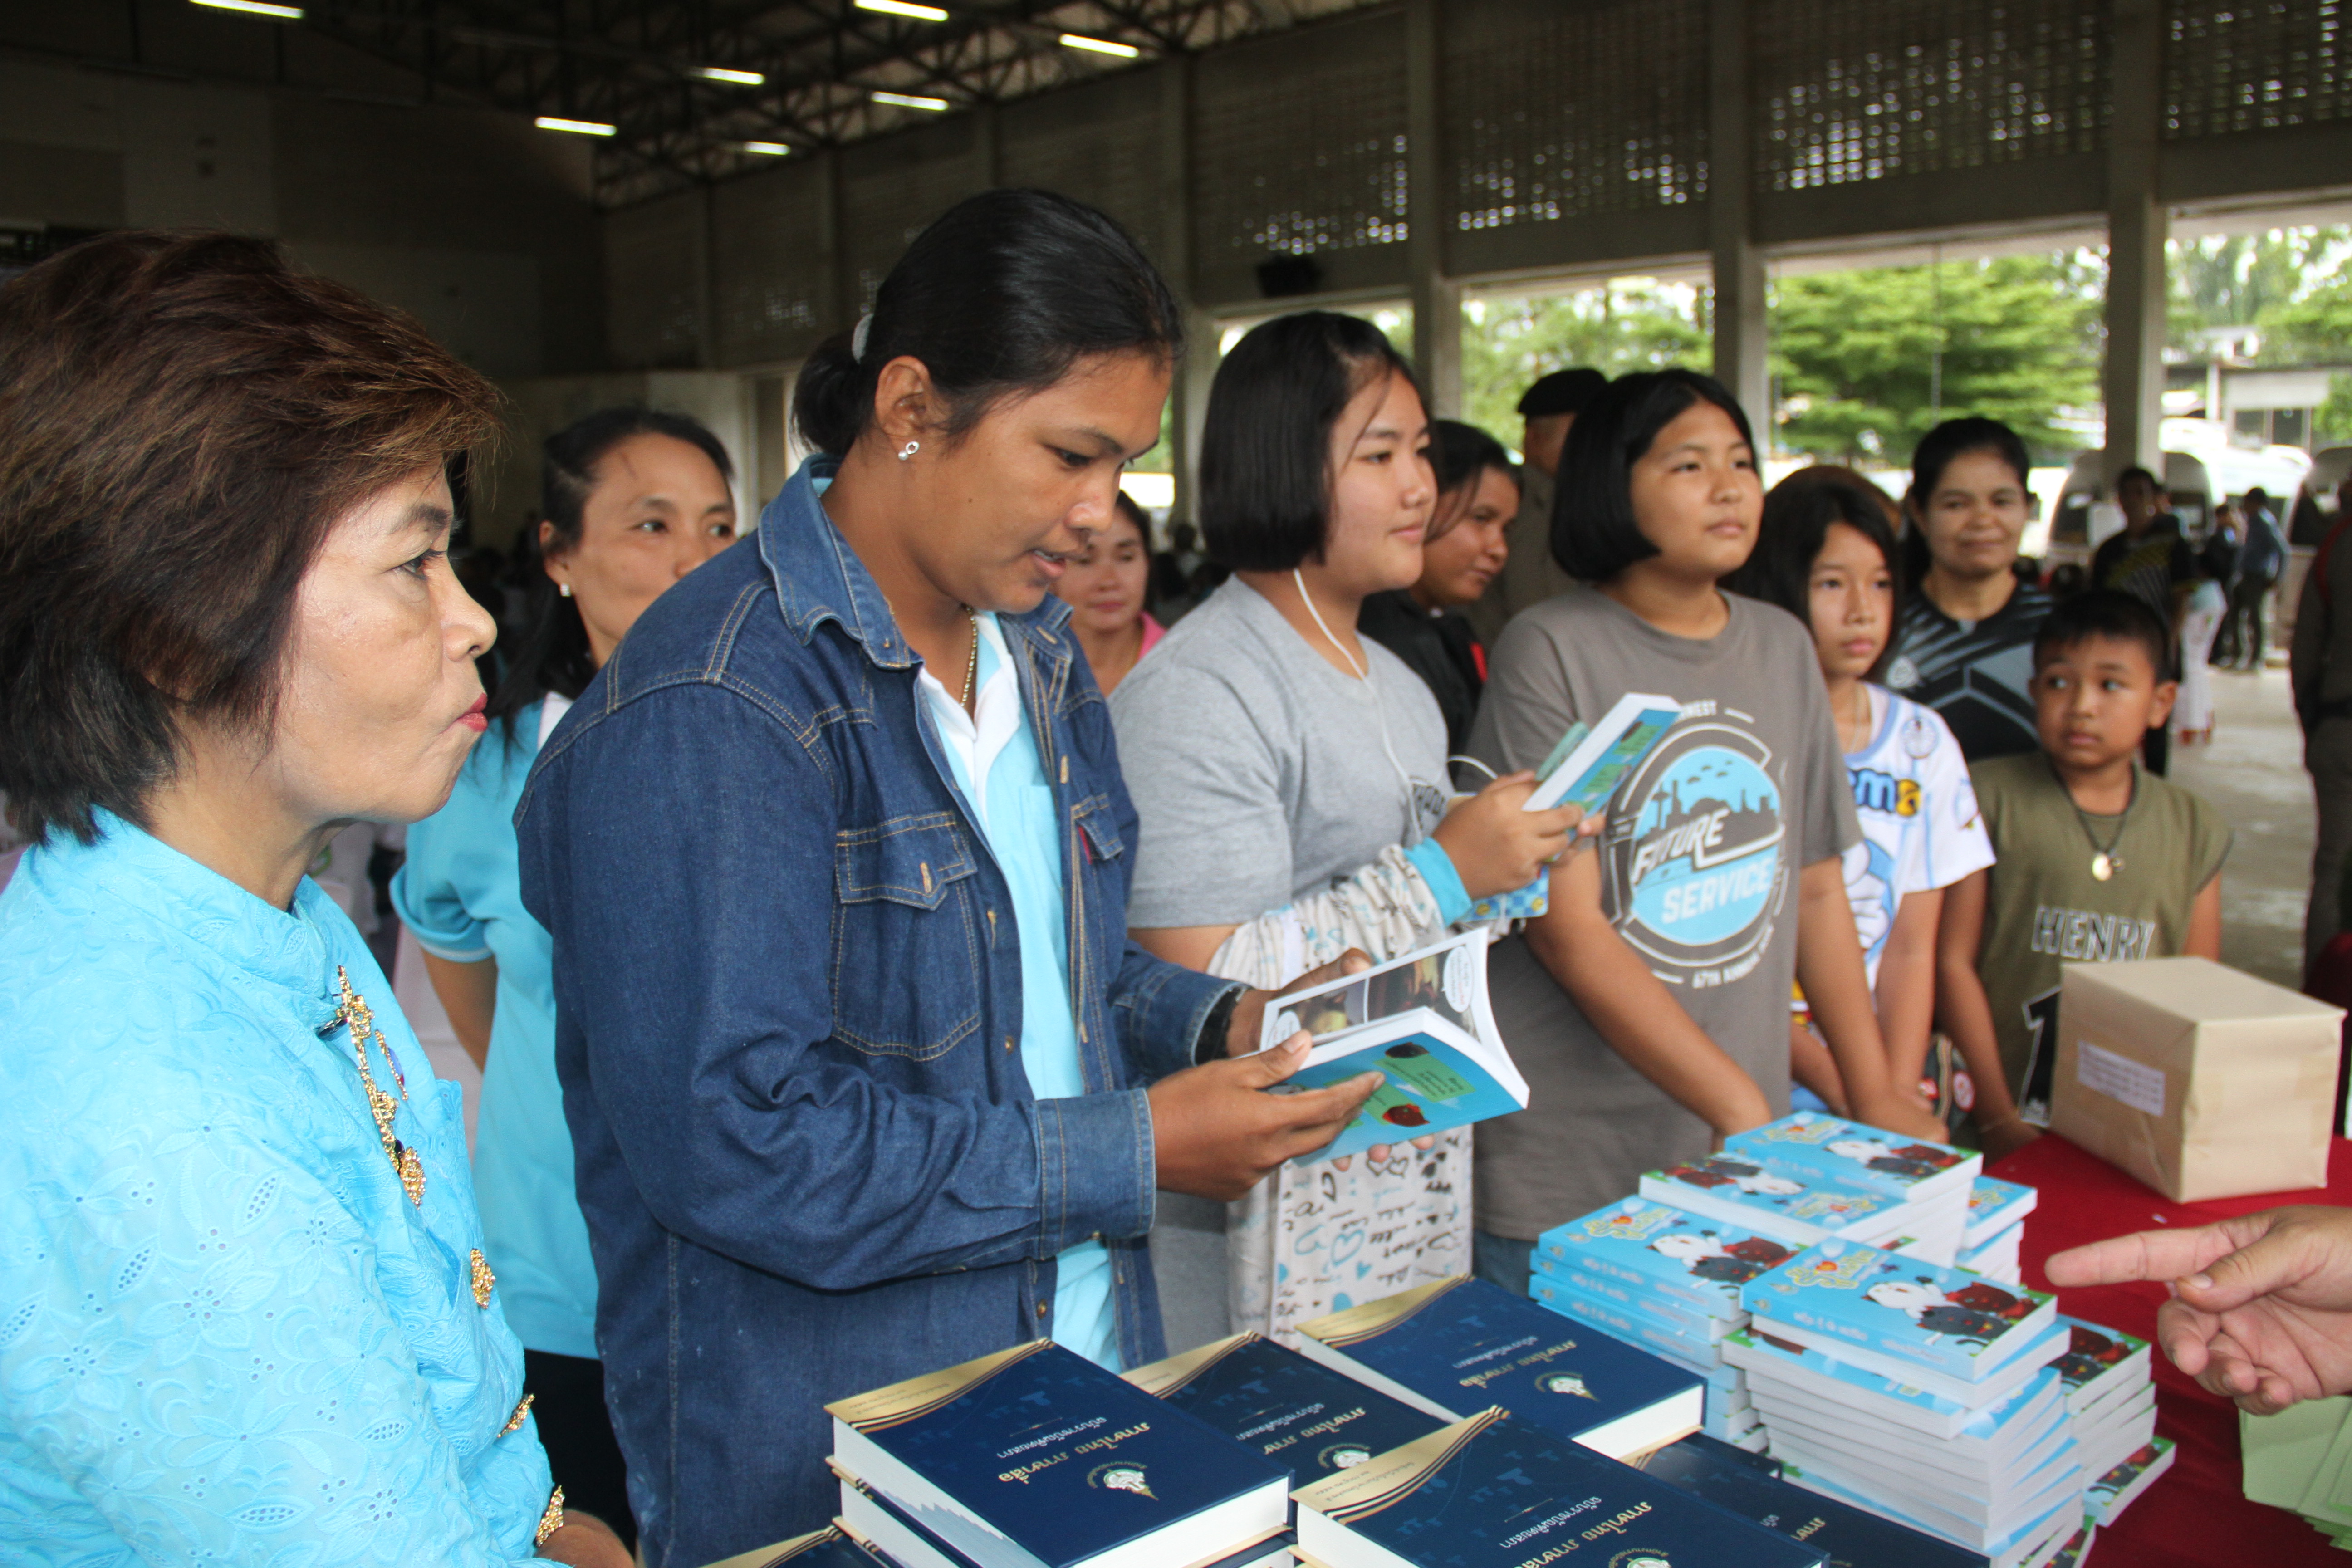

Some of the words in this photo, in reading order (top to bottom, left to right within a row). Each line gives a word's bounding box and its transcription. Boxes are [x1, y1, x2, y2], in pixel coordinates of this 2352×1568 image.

[1633, 808, 1730, 885] FUTURE
[1661, 856, 1775, 925] SERVICE
[2031, 905, 2156, 962] HENRY
[1074, 1421, 1151, 1454] ภาษาไทย
[998, 1451, 1069, 1485] ภาษาสื่อ
[1581, 1501, 1652, 1541] ภาษาไทย
